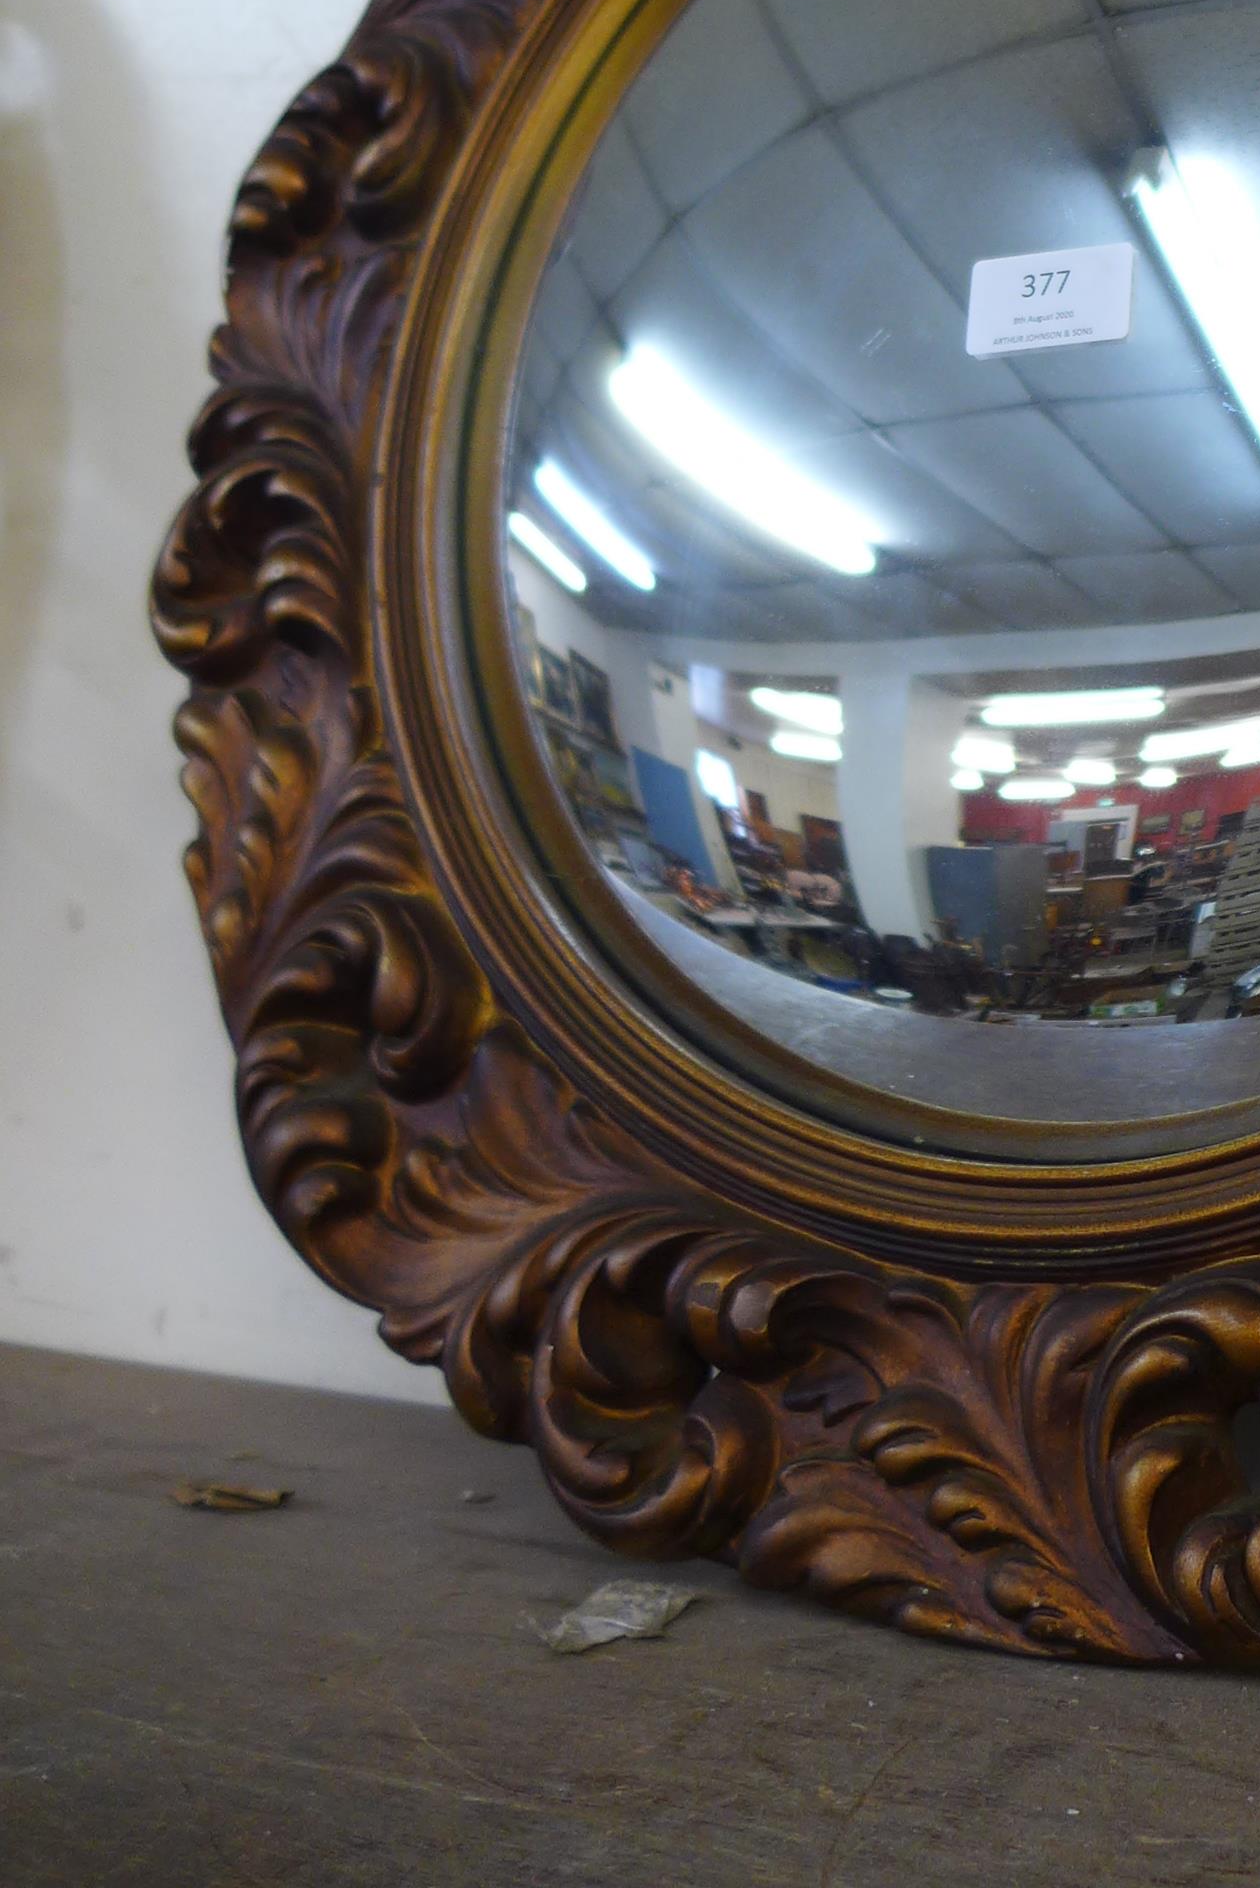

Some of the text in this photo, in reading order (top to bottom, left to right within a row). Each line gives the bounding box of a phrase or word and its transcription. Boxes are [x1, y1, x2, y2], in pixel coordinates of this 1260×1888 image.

[1021, 269, 1071, 298] 377
[1027, 313, 1054, 323] August
[993, 335, 1024, 345] ARTHUR
[1025, 330, 1063, 342] JOHNSON
[1072, 327, 1094, 337] SONS
